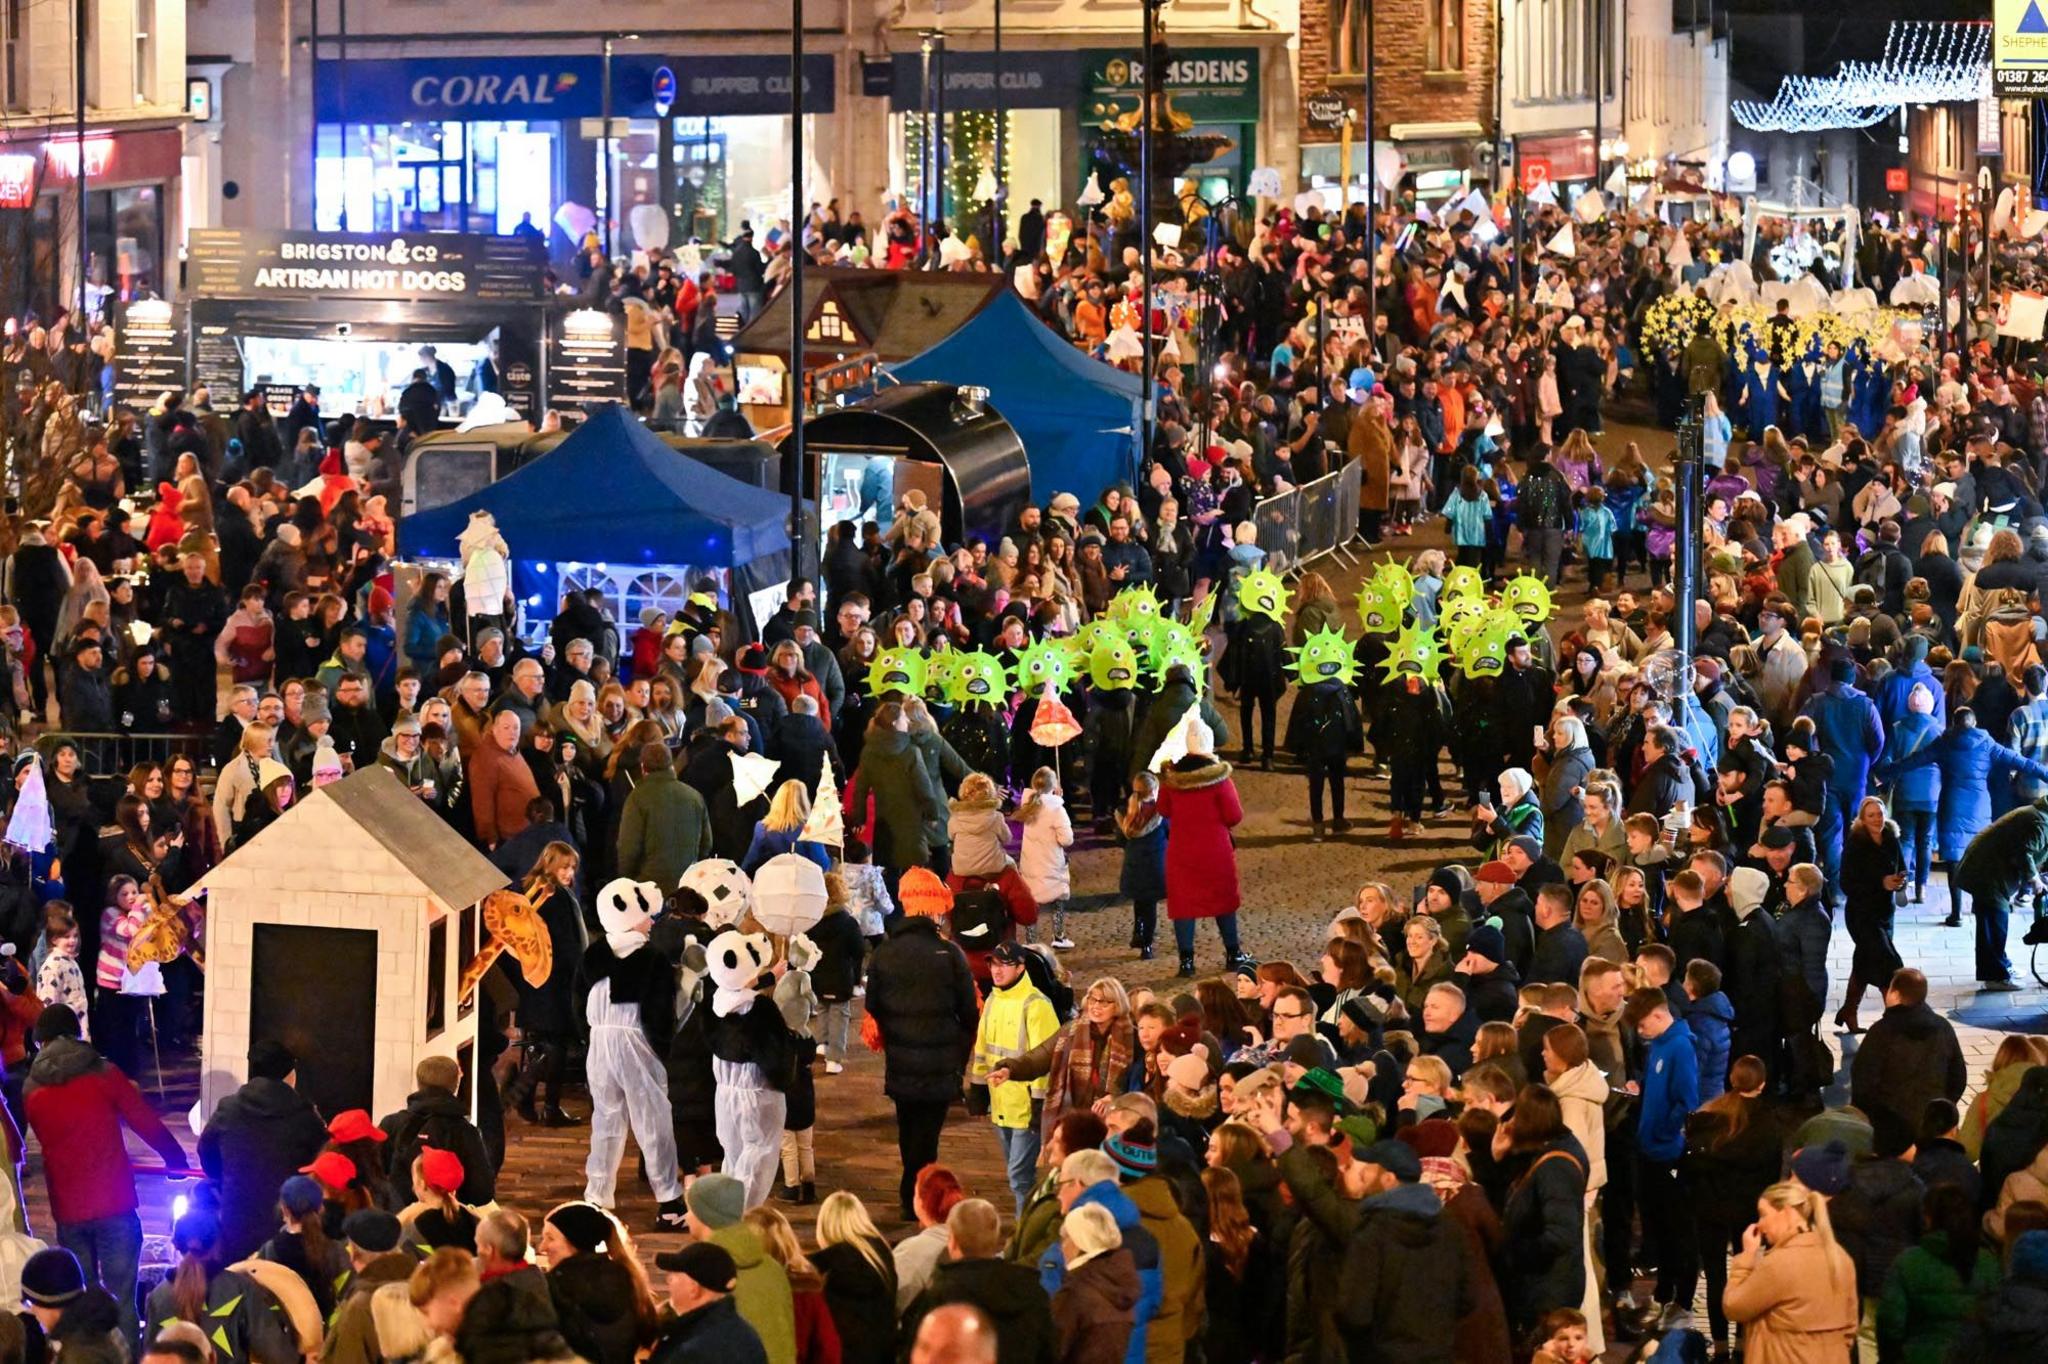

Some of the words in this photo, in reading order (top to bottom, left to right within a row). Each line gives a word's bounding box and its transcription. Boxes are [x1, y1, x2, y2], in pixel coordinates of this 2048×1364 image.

[941, 73, 995, 90] UPPER
[1001, 72, 1042, 89] CLUB
[1129, 60, 1249, 84] RMSDENS
[1997, 70, 2028, 83] 01387
[411, 73, 555, 107] CORAL
[691, 77, 759, 94] SUPPER
[1308, 100, 1342, 112] Crystal
[280, 243, 385, 262] BRIGSTON
[254, 267, 349, 289] ARTISAN
[351, 269, 399, 290] HOT
[401, 271, 466, 292] DOGS
[265, 386, 294, 394] PLEASE
